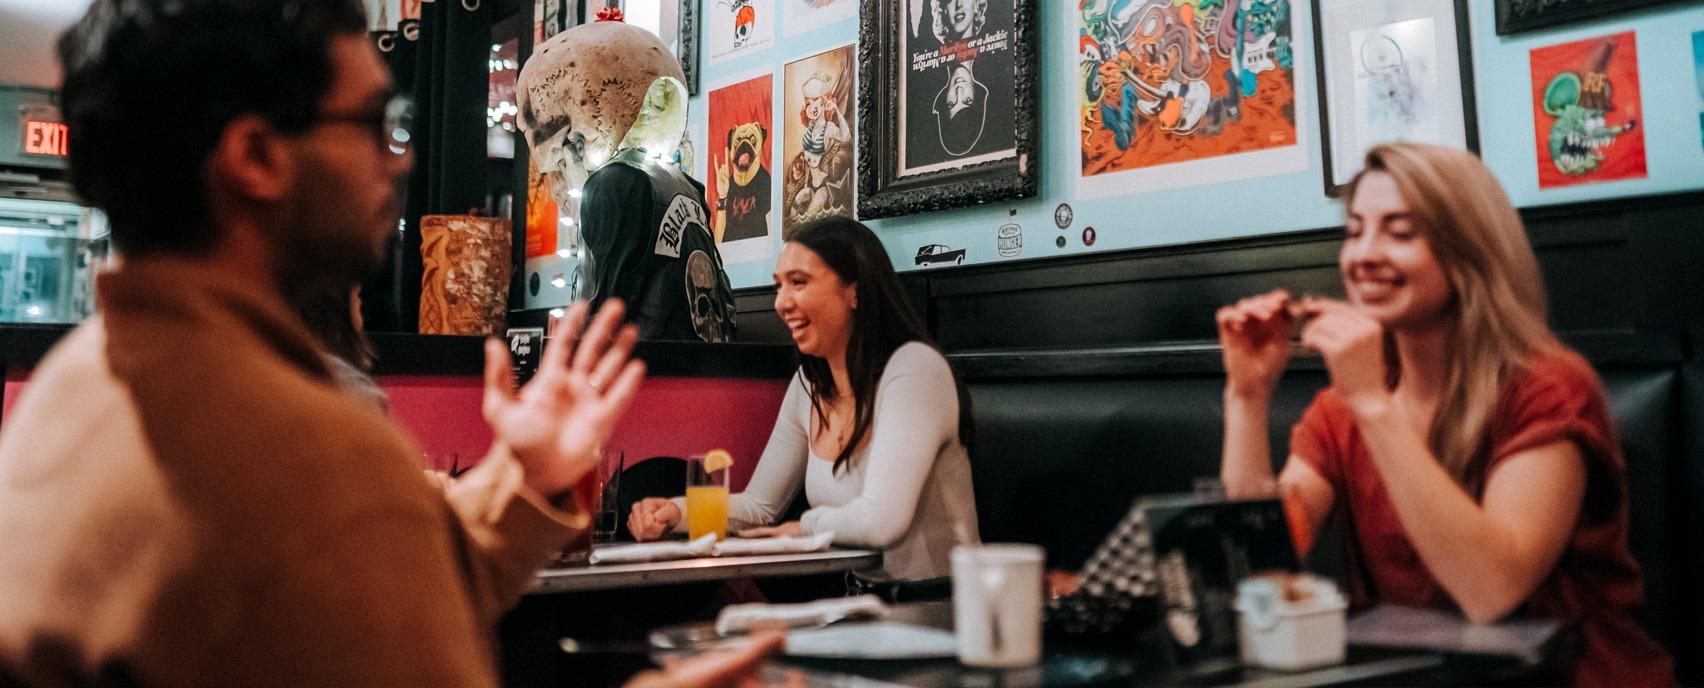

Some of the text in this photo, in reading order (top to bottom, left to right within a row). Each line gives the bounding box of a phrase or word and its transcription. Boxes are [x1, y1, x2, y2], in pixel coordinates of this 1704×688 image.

[912, 49, 933, 63] You're
[933, 50, 939, 58] a
[977, 38, 983, 46] a
[983, 29, 1008, 44] Jackie
[25, 121, 68, 156] EXIT
